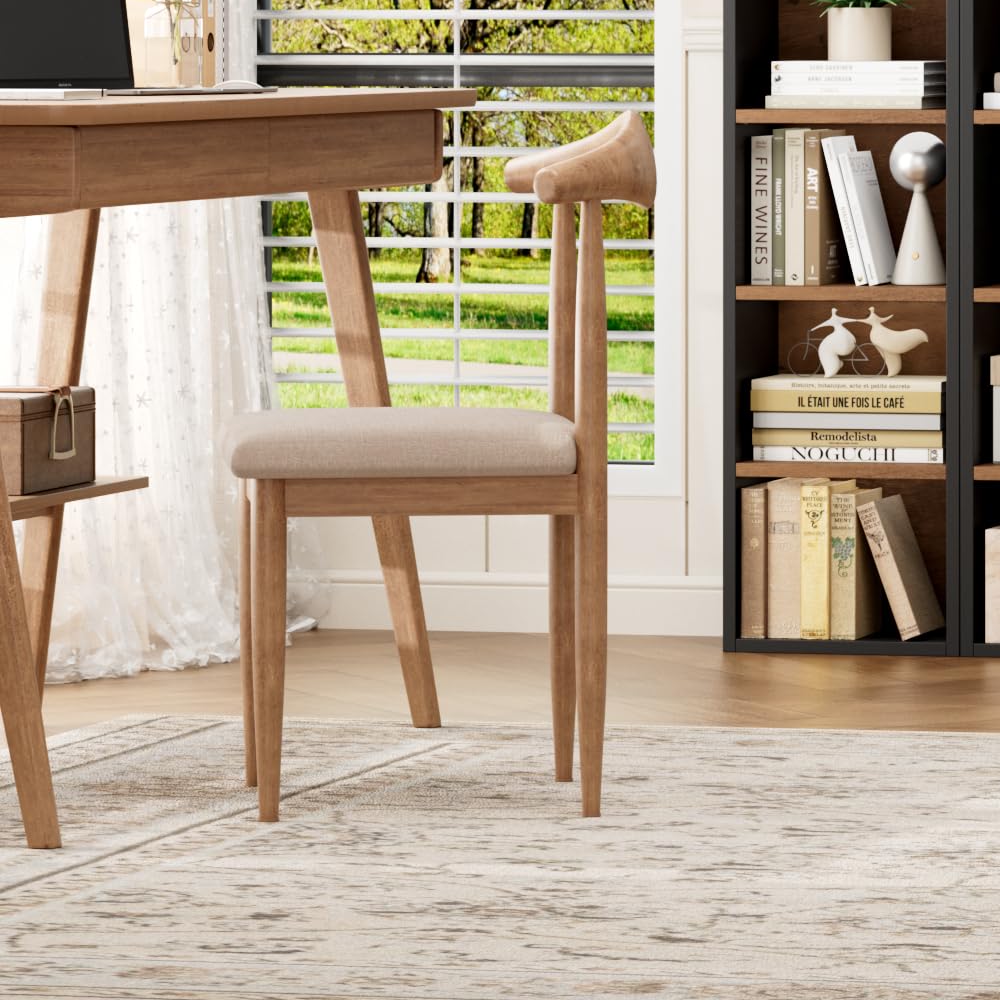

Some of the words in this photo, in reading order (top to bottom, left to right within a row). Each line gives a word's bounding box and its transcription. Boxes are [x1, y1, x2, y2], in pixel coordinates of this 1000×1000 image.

[755, 157, 768, 197] FINE
[806, 168, 819, 193] ART
[755, 206, 768, 265] WINES
[798, 396, 806, 407] IL
[807, 394, 830, 407] ÉTAIT
[833, 396, 849, 408] UNE
[851, 396, 869, 408] FOIS
[871, 397, 881, 408] LE
[883, 395, 905, 408] CAFÉ
[810, 431, 877, 442] Remodelista
[791, 446, 896, 462] NOGUCHI
